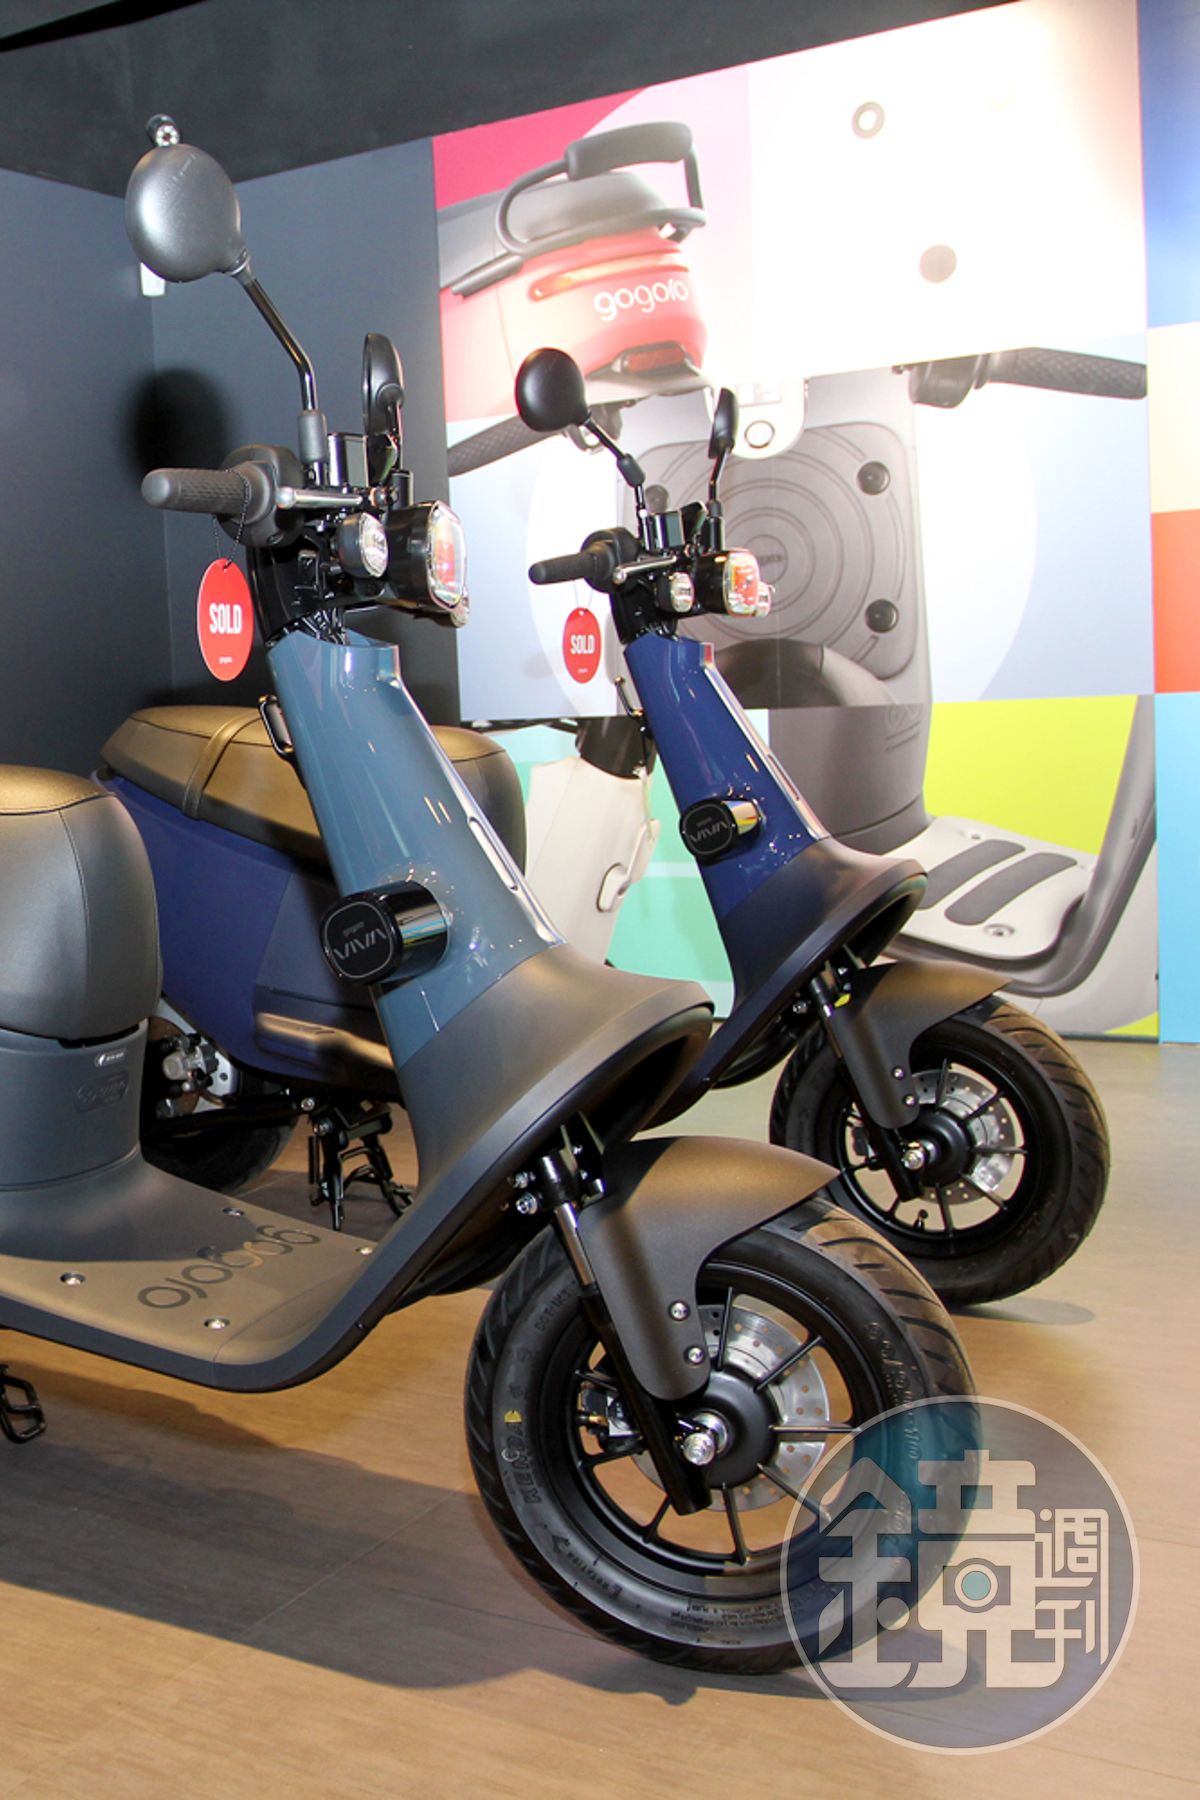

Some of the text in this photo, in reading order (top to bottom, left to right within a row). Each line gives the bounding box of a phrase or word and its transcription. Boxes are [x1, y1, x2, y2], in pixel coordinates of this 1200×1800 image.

[592, 278, 689, 322] gogoro
[209, 602, 243, 635] SOLD
[570, 634, 596, 655] SOLD
[689, 820, 729, 843] VIVA
[333, 927, 388, 960] VIVA
[136, 1224, 322, 1309] gogoro
